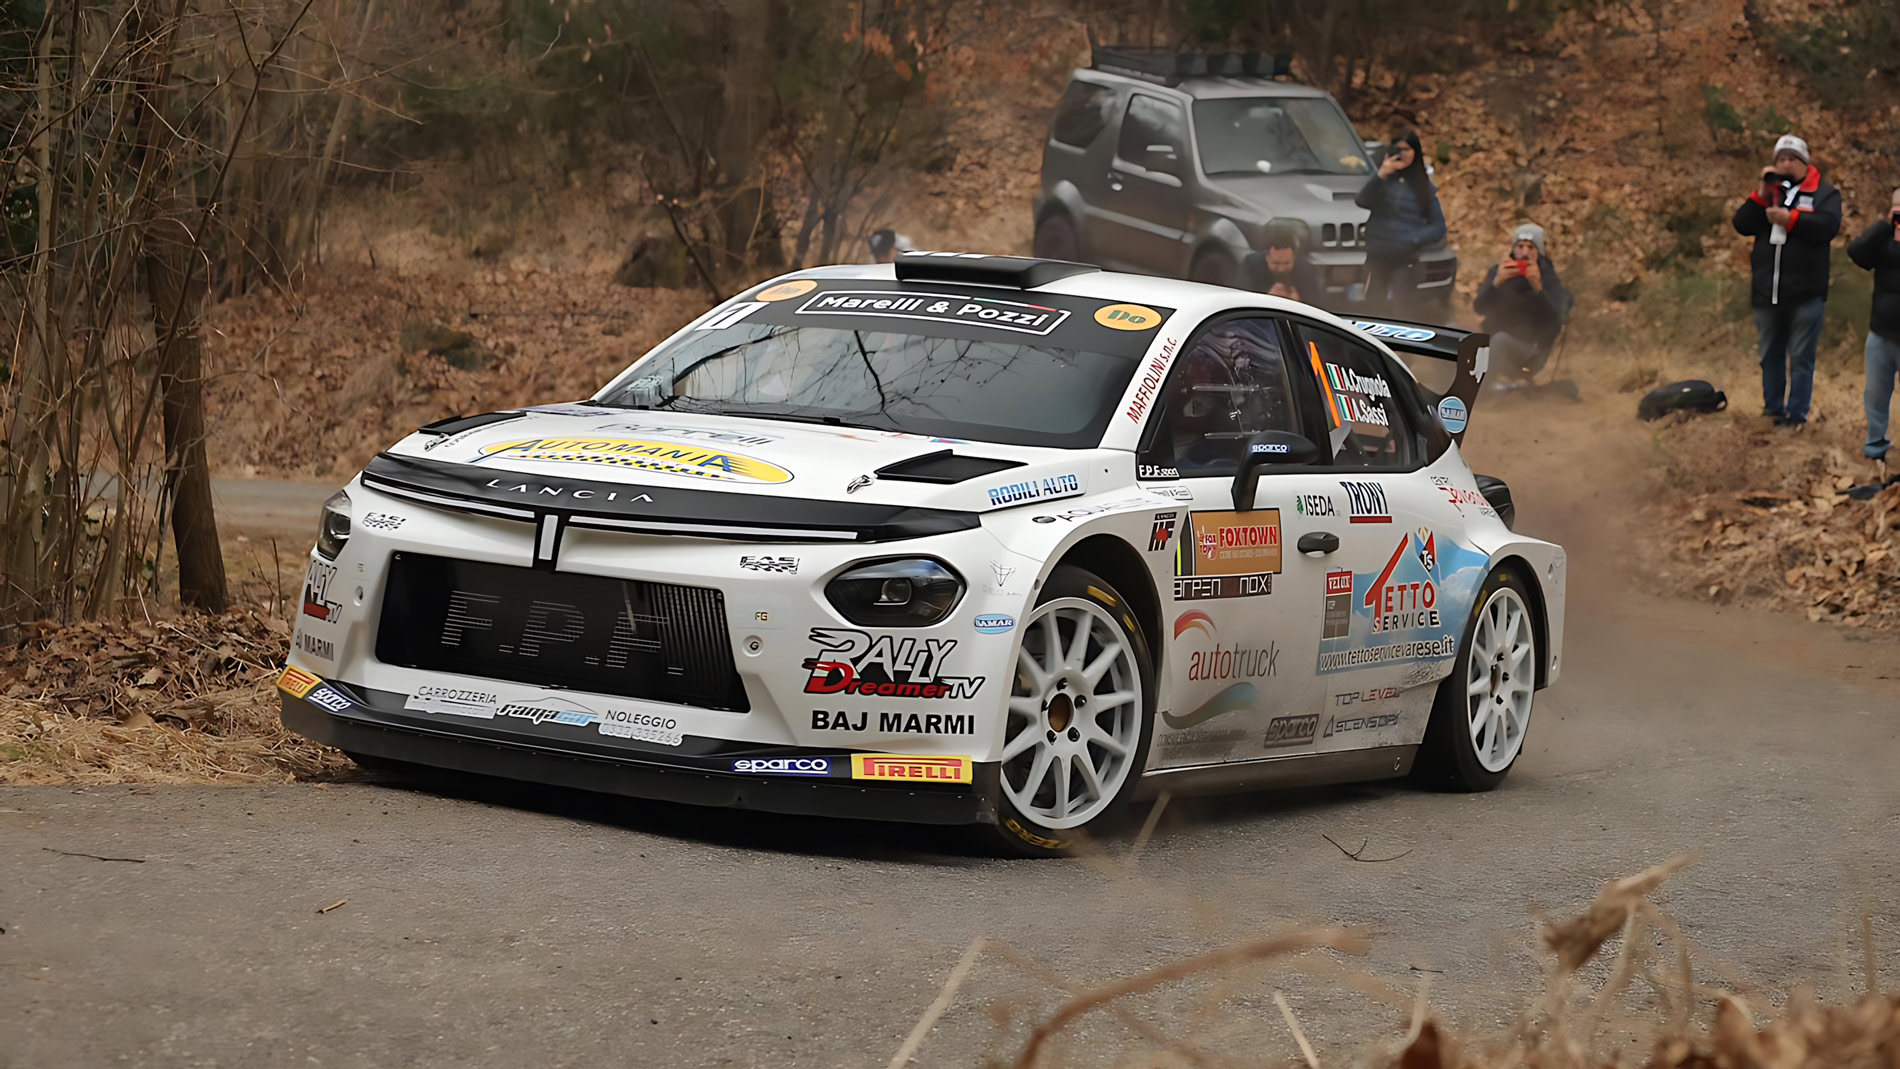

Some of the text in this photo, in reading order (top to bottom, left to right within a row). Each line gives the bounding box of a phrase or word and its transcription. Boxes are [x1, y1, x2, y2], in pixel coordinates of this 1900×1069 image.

[926, 301, 950, 313] &
[956, 304, 1049, 326] Pozzi
[1126, 359, 1167, 424] MAFFIOLINI
[1309, 341, 1342, 428] 1
[506, 439, 732, 473] AUTOMANIA
[486, 479, 653, 503] LANCIA
[1043, 474, 1079, 496] AUTO
[1304, 495, 1336, 516] ISEDA
[1339, 481, 1389, 515] TRONY
[1219, 526, 1277, 548] FOXTOWN
[1373, 610, 1441, 633] SERVICE
[1189, 641, 1280, 681] autotruck
[418, 685, 497, 704] CARROZZERIA
[605, 710, 677, 730] NOLEGGIO
[811, 710, 975, 735] BAJ MARMI
[735, 759, 829, 778] sparco
[862, 757, 963, 780] PIRELLI
